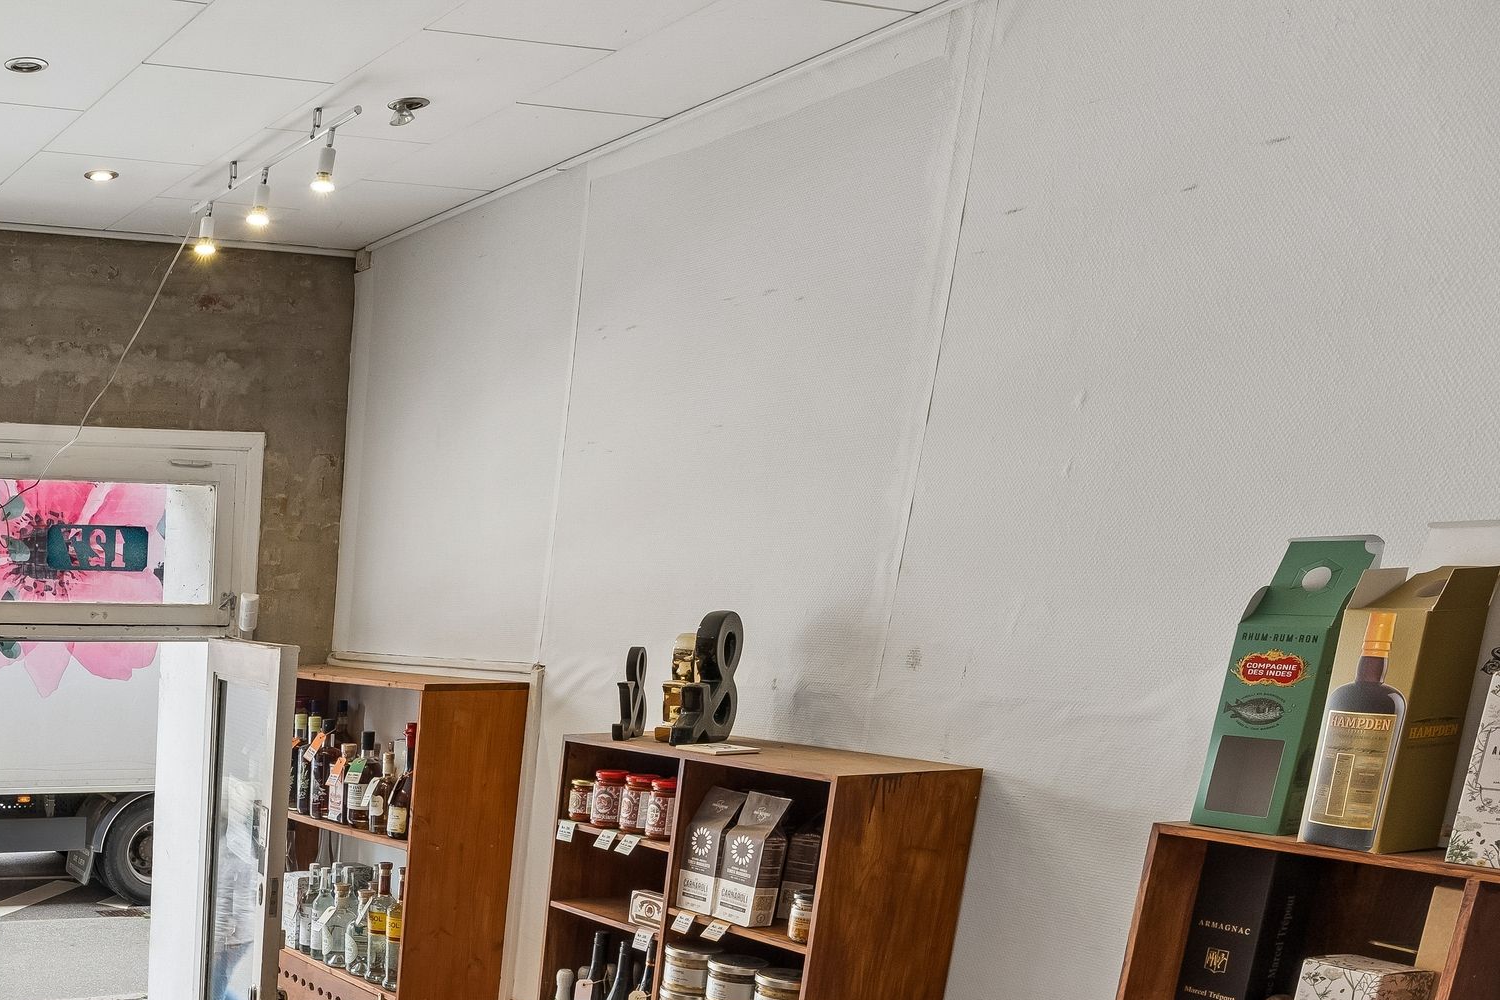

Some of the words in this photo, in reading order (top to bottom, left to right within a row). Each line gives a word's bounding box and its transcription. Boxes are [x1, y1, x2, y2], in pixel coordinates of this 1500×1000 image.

[1246, 662, 1298, 671] COMPAGNIE
[1247, 668, 1264, 676] DES
[1266, 669, 1292, 678] INDES
[1330, 714, 1392, 731] HAMPDEN
[1409, 724, 1459, 739] HAMPDEN
[1198, 919, 1251, 936] ARMAGNAC
[1184, 985, 1208, 997] Marcel
